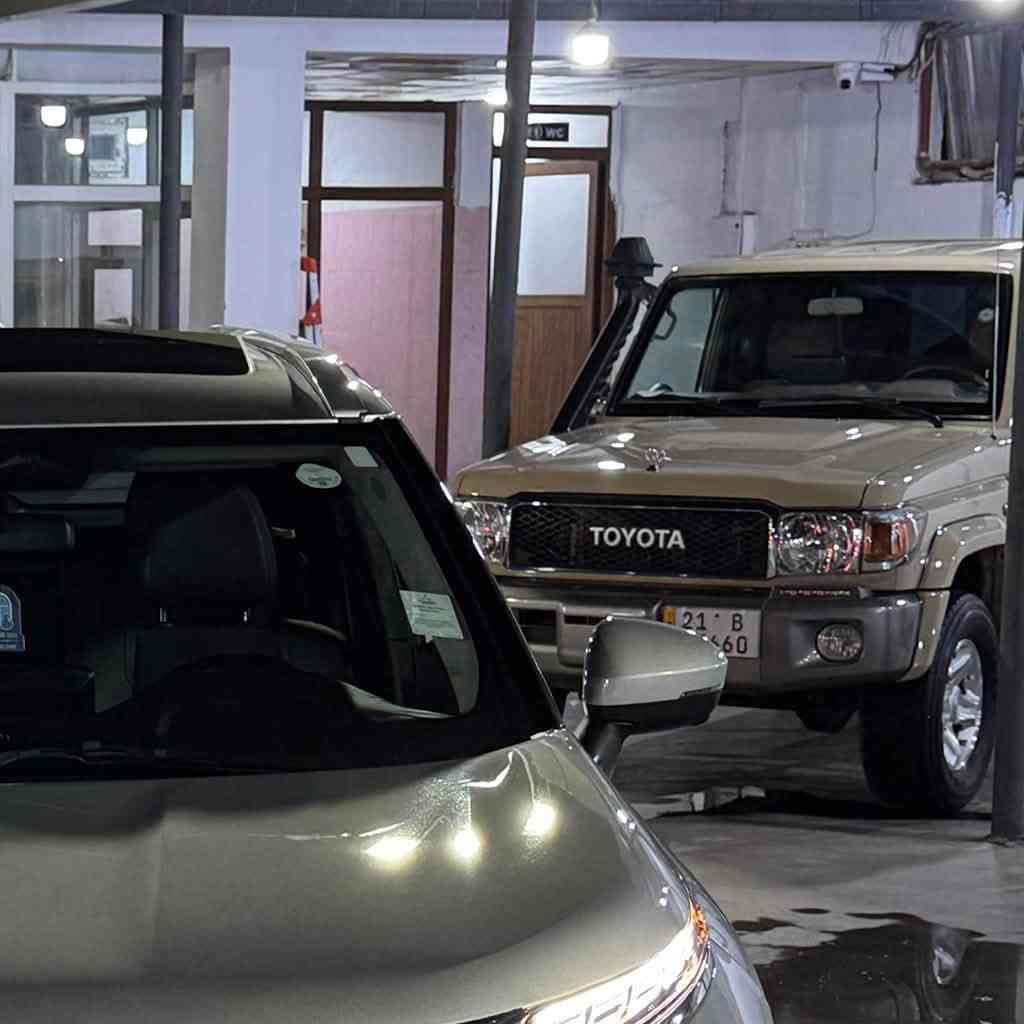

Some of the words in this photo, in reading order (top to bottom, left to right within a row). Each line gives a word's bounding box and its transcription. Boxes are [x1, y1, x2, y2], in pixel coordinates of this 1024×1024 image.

[544, 126, 565, 139] WC
[589, 526, 686, 549] TOYOTA
[681, 611, 707, 631] 21
[731, 613, 743, 632] B
